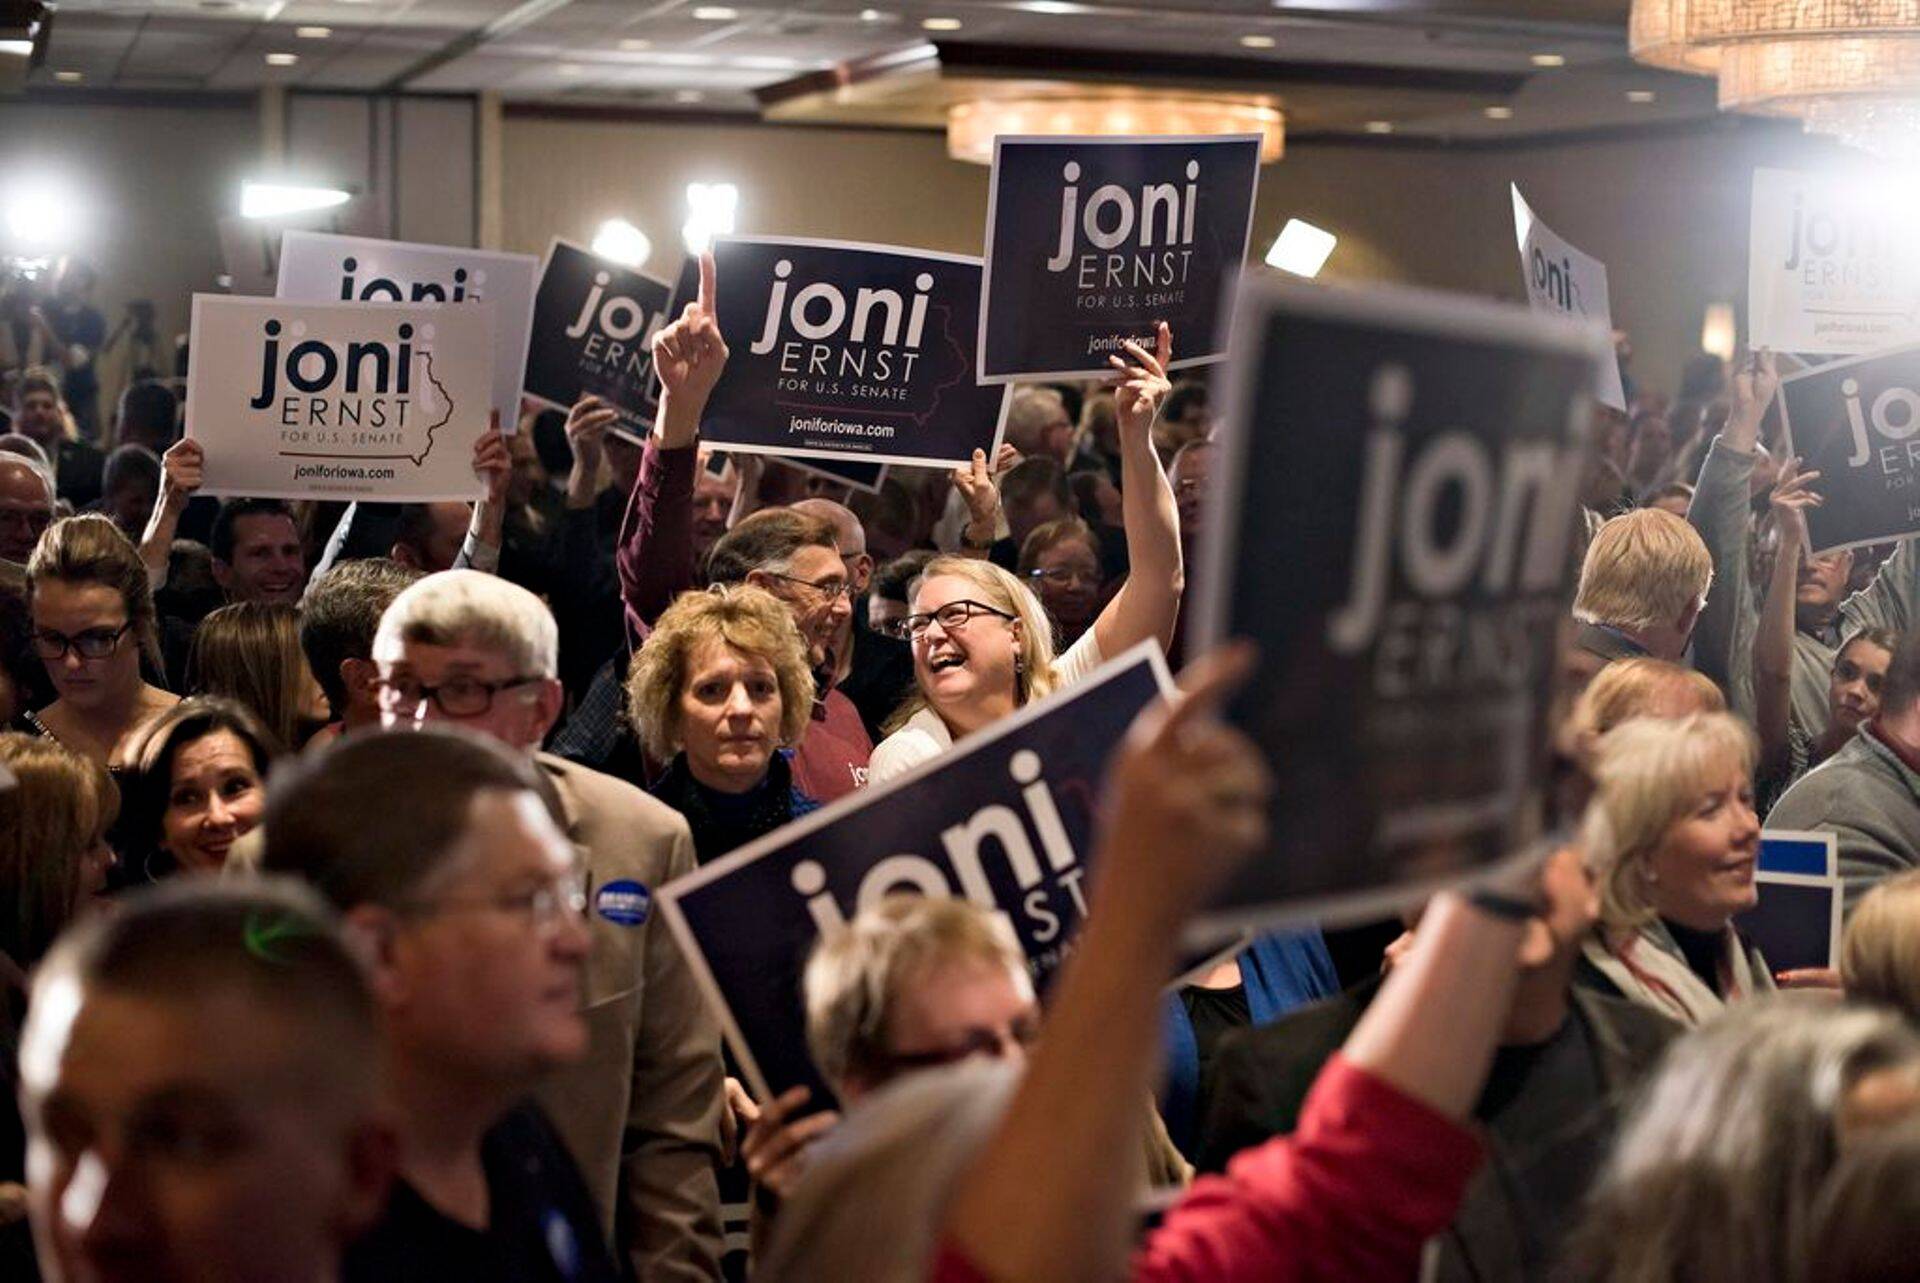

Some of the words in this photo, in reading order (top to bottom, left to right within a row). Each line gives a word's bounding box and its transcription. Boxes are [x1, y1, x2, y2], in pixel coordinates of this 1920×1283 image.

[1047, 160, 1200, 273] joni
[1078, 250, 1193, 289] ERNST
[751, 259, 935, 356] joni
[1077, 295, 1106, 309] FOR
[1112, 295, 1140, 309] U.S.
[250, 319, 414, 410] joni
[780, 342, 920, 383] ERNST
[777, 378, 809, 392] FOR
[815, 381, 845, 395] U.S.
[851, 384, 908, 401] SENATE
[281, 397, 411, 428] ERNST
[789, 415, 895, 438] joniforiowa.com
[281, 430, 311, 443] FOR
[316, 431, 345, 445] U.S.
[351, 431, 404, 446] SENATE
[293, 463, 395, 481] joniforiowa.com
